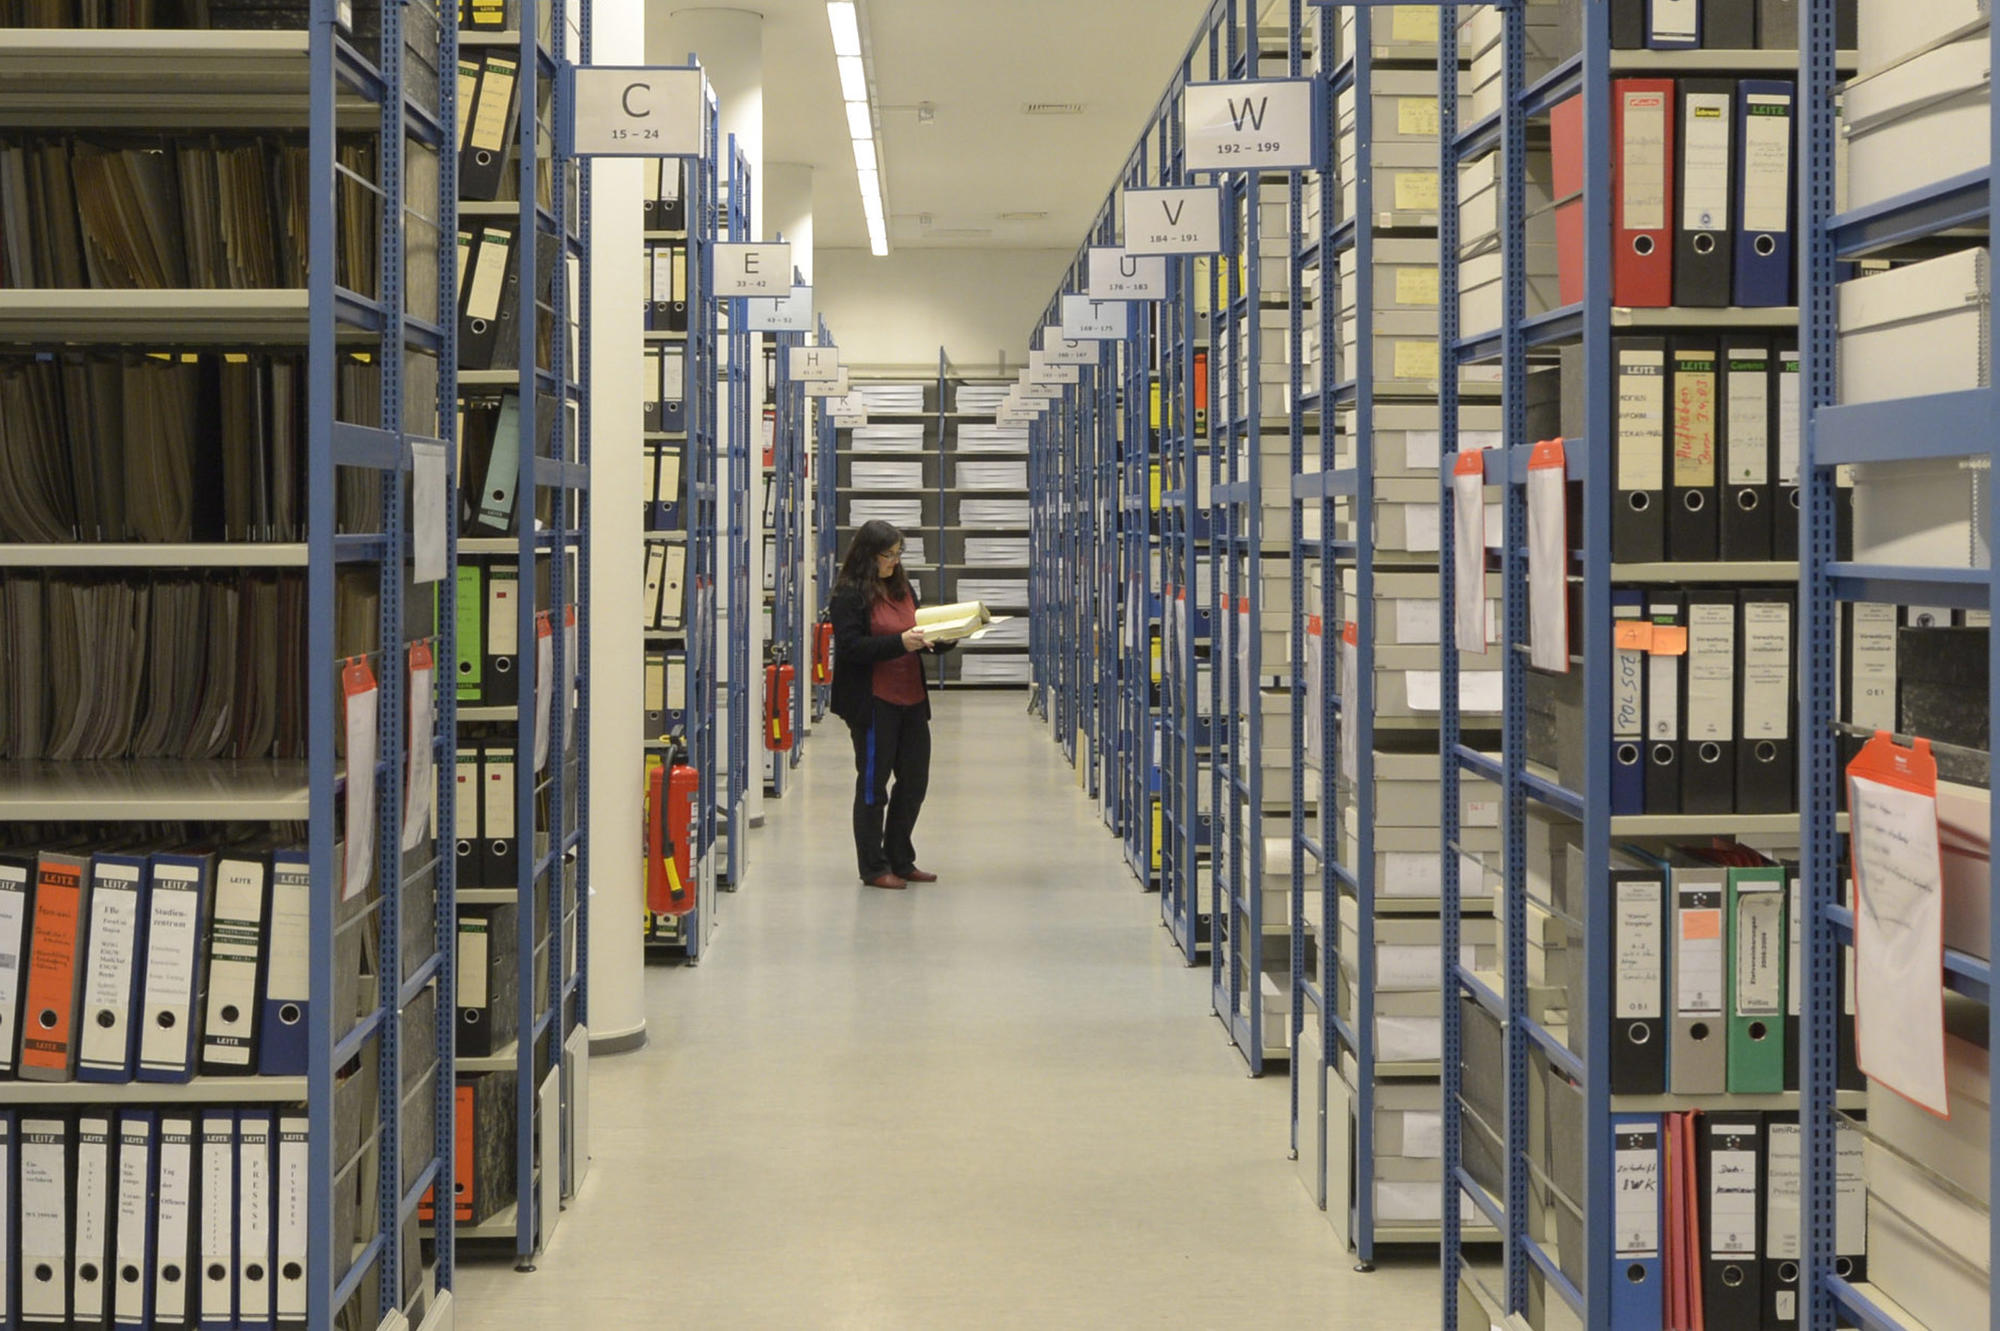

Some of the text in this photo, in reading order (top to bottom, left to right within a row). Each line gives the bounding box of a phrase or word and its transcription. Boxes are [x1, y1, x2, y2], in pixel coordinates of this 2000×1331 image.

[622, 83, 651, 118] C
[1228, 96, 1269, 132] W
[1751, 106, 1785, 115] LEITZ
[611, 129, 628, 139] 15
[643, 129, 660, 139] 24
[1217, 143, 1240, 154] 192
[1257, 141, 1281, 153] 199
[1162, 199, 1184, 226] V
[1150, 235, 1169, 243] 184
[1180, 234, 1198, 242] 191
[744, 252, 760, 274] E
[1119, 256, 1136, 278] U
[1089, 302, 1103, 320] T
[807, 352, 819, 366] H
[1627, 366, 1655, 374] LEITZ
[1681, 362, 1711, 371] LEITZ
[44, 873, 75, 886] LEITZ
[103, 878, 129, 890] LEITZ
[230, 876, 252, 885] LEITZ
[162, 880, 189, 890] LEITZ
[30, 1134, 55, 1143] LEITZ
[83, 1134, 104, 1142] LEITZ
[124, 1136, 144, 1144] LEITZ
[165, 1135, 187, 1143] LEITZ
[206, 1134, 228, 1142] LEITZ
[244, 1135, 265, 1143] LEITZ
[283, 1133, 305, 1141] LEITZ
